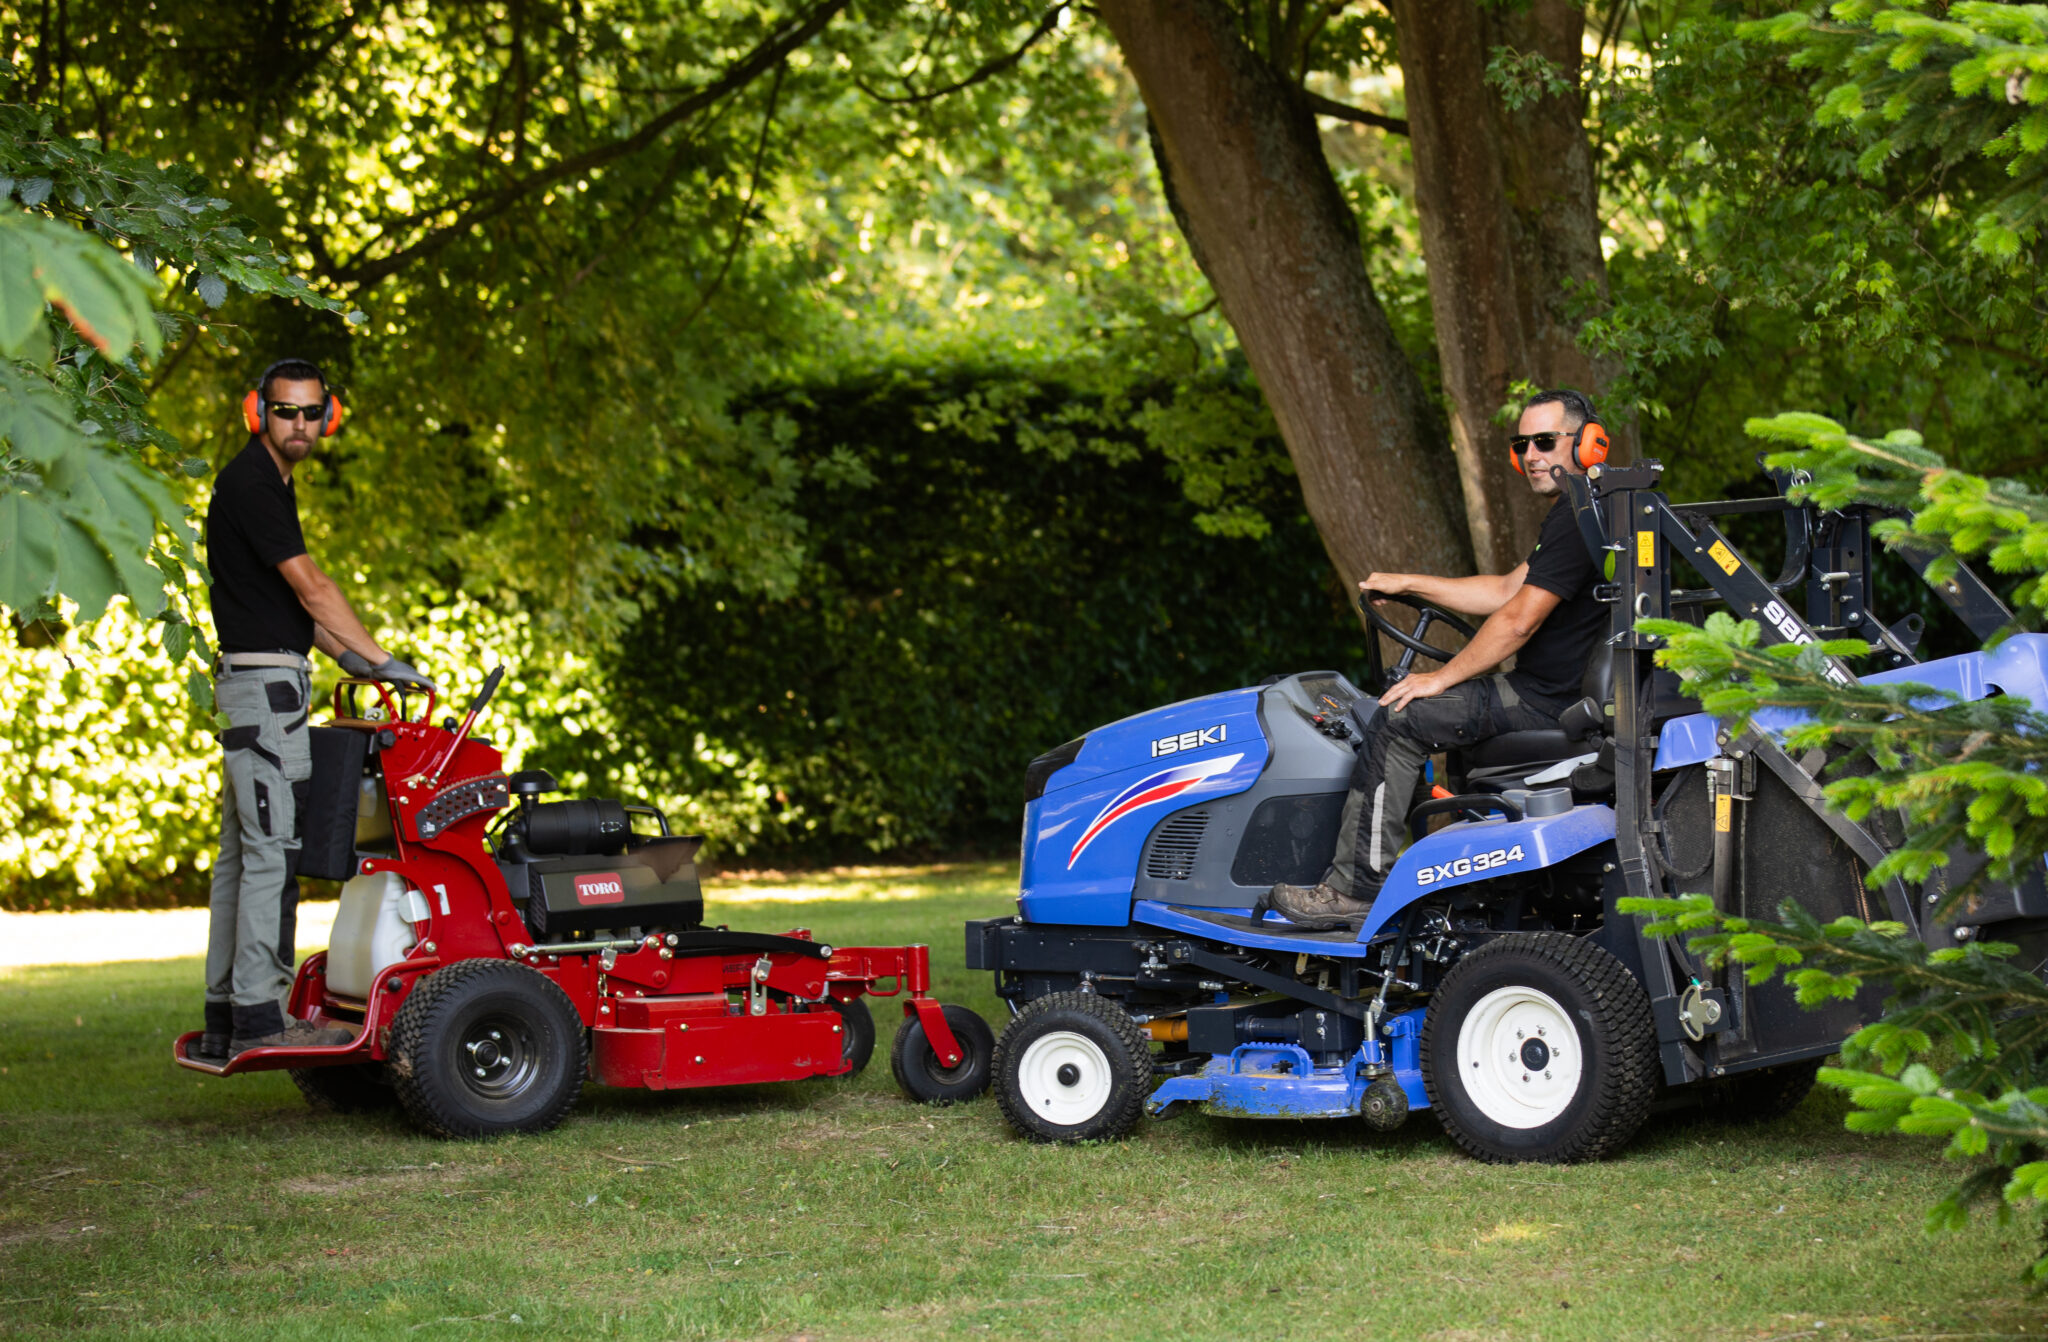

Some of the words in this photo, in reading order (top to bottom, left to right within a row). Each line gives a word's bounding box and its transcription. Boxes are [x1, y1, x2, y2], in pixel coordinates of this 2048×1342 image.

[1151, 723, 1227, 758] ISEKI
[1416, 844, 1526, 886] SXG324
[578, 881, 621, 897] TORO
